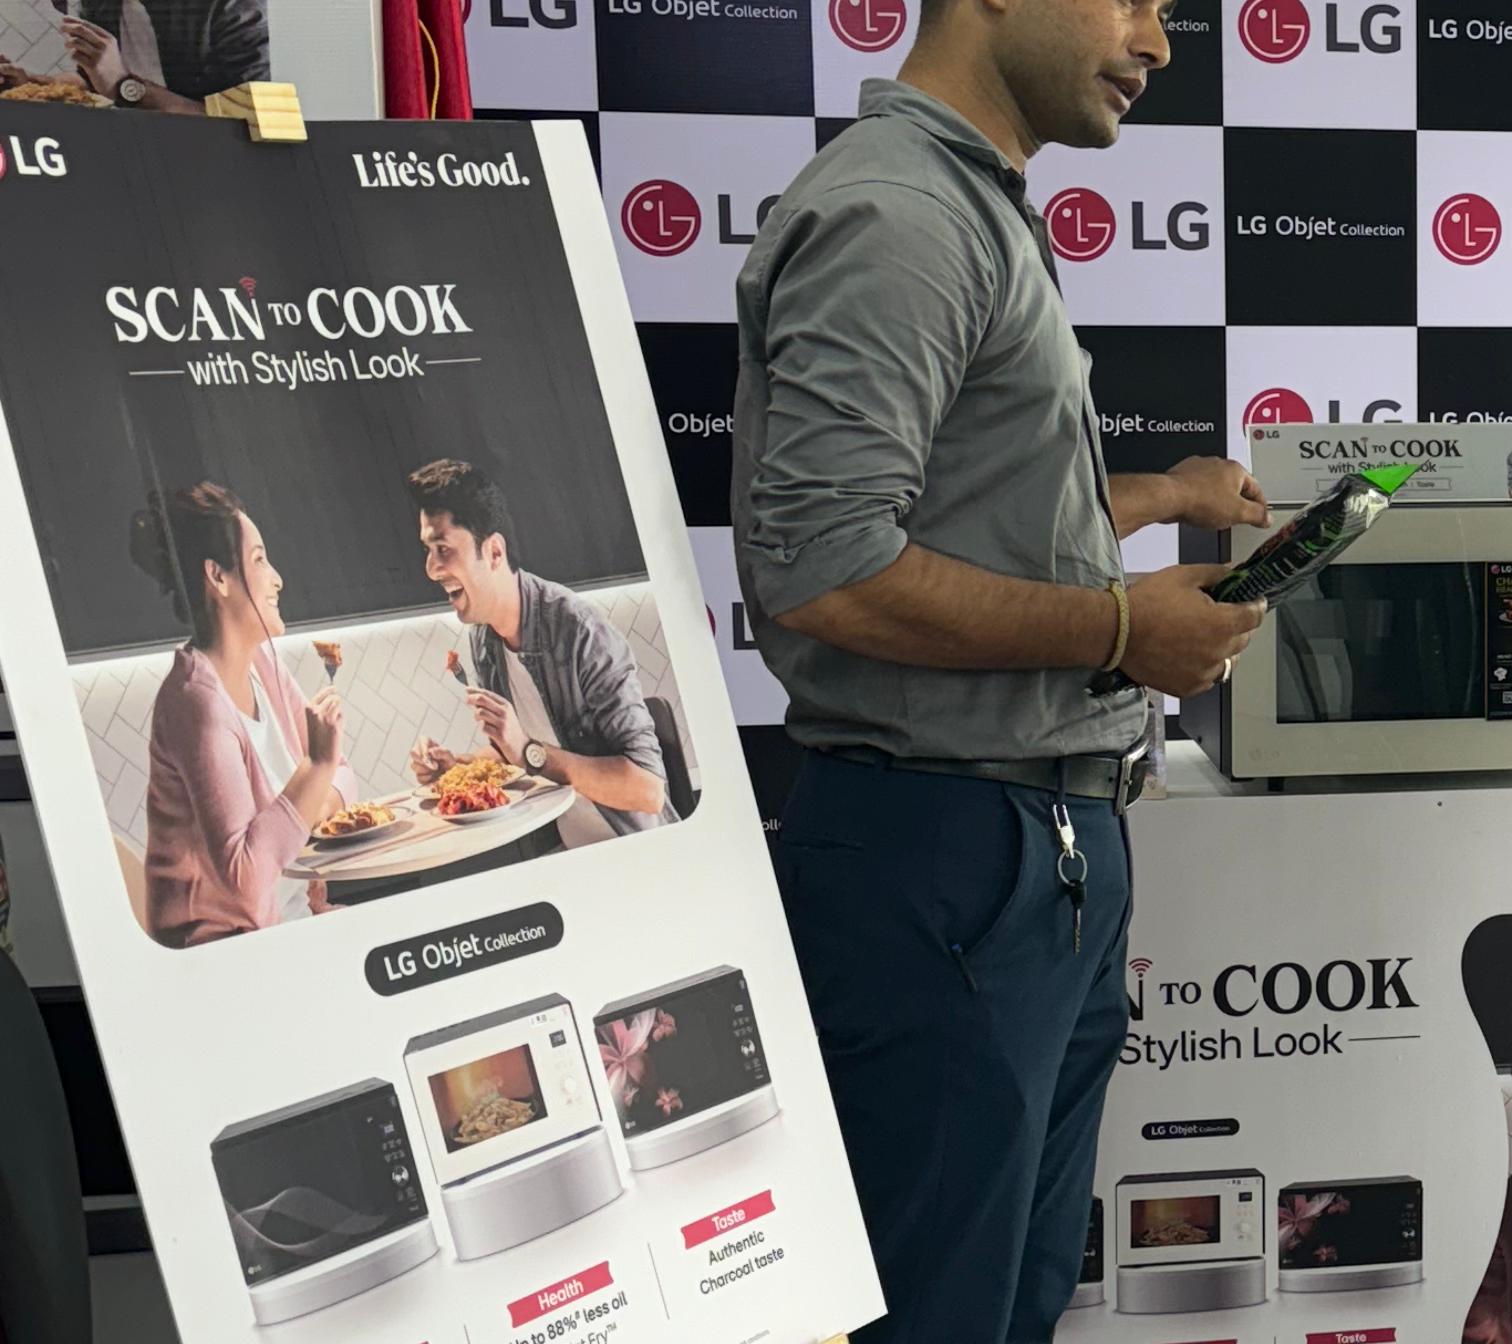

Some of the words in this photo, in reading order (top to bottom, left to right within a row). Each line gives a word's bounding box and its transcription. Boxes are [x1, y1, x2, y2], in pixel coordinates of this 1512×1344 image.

[725, 4, 797, 19] Collection
[1326, 3, 1401, 54] LG
[12, 137, 67, 176] LG
[353, 152, 435, 186] Life's
[437, 152, 530, 186] Good.
[1132, 202, 1209, 250] LG
[1238, 216, 1266, 234] LG
[1340, 224, 1404, 236] Collection
[106, 287, 265, 342] SCAN
[268, 303, 301, 325] TO
[308, 284, 472, 339] COOK
[187, 352, 248, 385] with
[252, 350, 347, 390] Stylish
[354, 349, 425, 381] Look
[1148, 420, 1214, 432] Collection
[1266, 430, 1280, 438] LG
[1299, 440, 1367, 459] SCAN
[1372, 445, 1386, 453] TO
[1390, 440, 1462, 458] COOK
[1328, 462, 1355, 473] with
[384, 952, 416, 980] LG
[423, 934, 482, 968] Objet
[484, 926, 546, 952] Collection
[1160, 982, 1201, 1004] TO
[1213, 956, 1419, 1013] COOK
[1254, 1024, 1342, 1057] Look
[1151, 1124, 1166, 1136] LG
[711, 1209, 746, 1232] Taste
[708, 1229, 765, 1266] Authentic
[699, 1259, 754, 1295] Charcoal
[753, 1246, 785, 1271] taste
[538, 1279, 584, 1311] Health
[583, 1303, 610, 1323] less
[611, 1291, 628, 1313] oil
[1335, 1332, 1367, 1344] Taste
